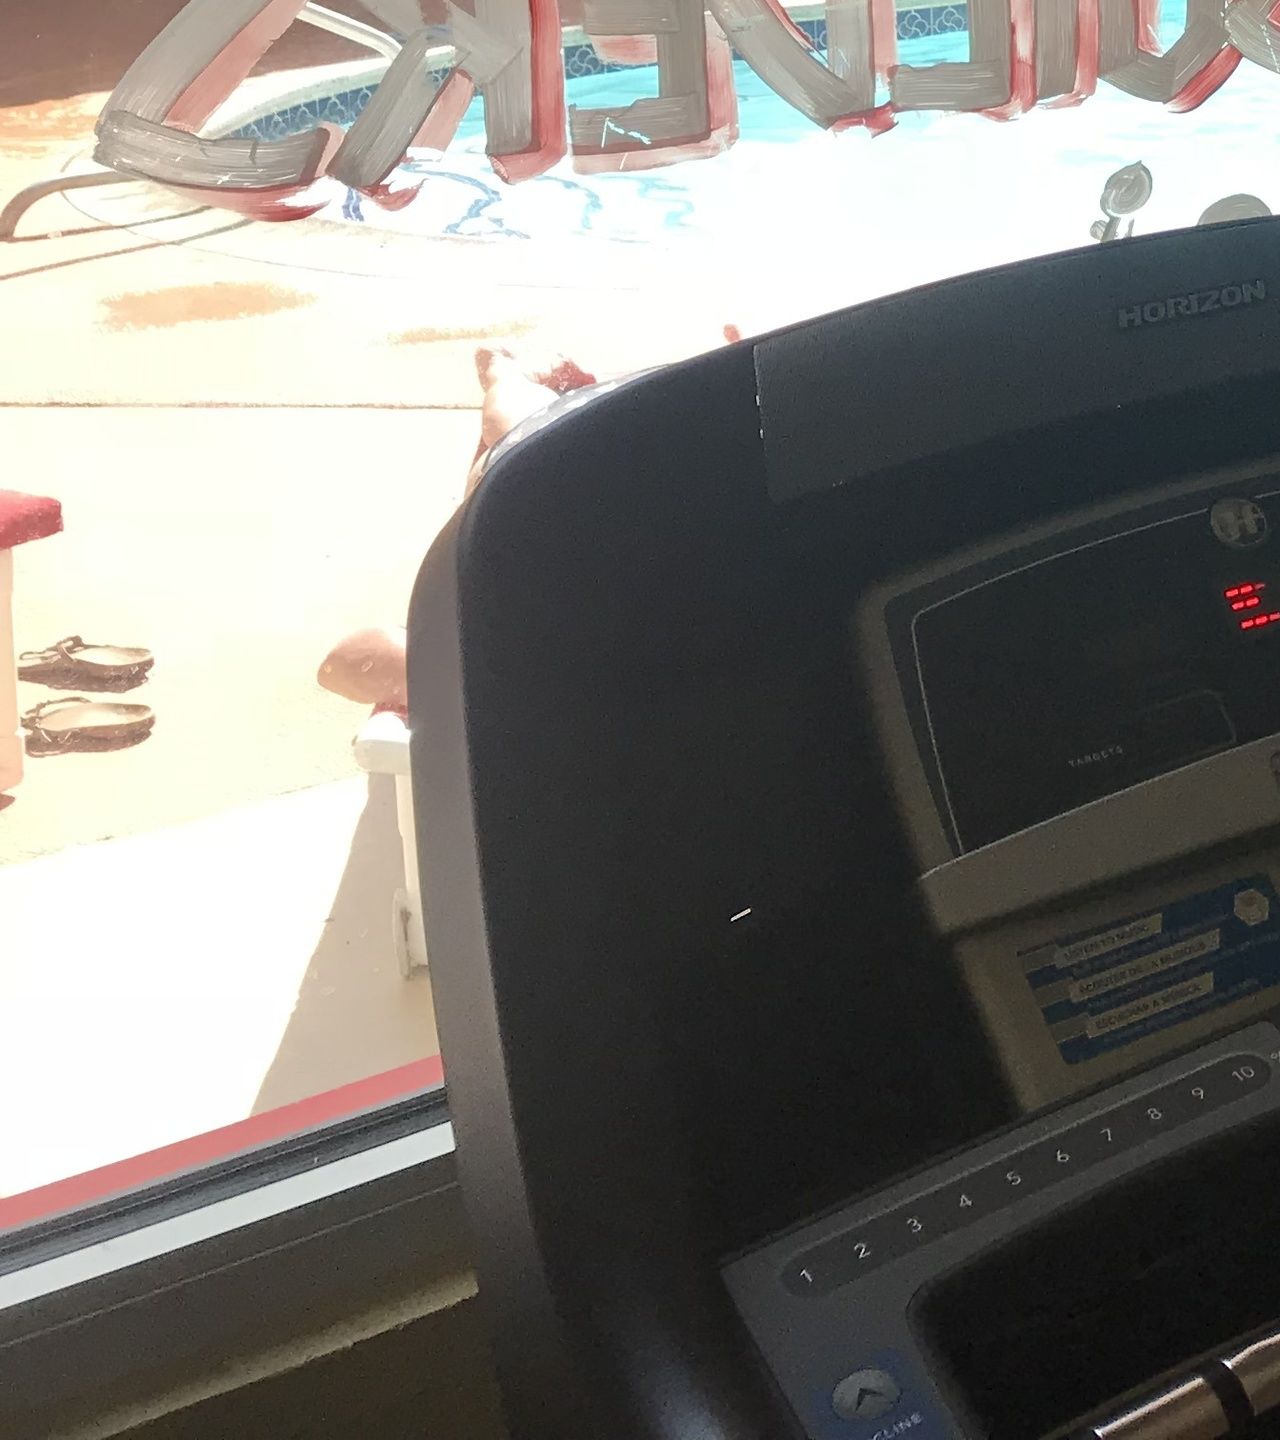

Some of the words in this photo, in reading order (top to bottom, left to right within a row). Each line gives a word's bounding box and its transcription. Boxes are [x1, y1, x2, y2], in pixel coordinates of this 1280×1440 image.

[1118, 278, 1268, 329] HORIZON
[799, 1267, 814, 1284] 1
[853, 1241, 872, 1261] 2
[906, 1217, 923, 1235] 3
[958, 1192, 973, 1210] 4
[1006, 1170, 1023, 1187] 5
[1055, 1148, 1070, 1165] 6
[1101, 1126, 1115, 1143] 7
[1147, 1106, 1163, 1123] 8
[1191, 1086, 1206, 1103] 9
[1232, 1064, 1256, 1083] 10
[872, 1410, 925, 1440] CLINE
